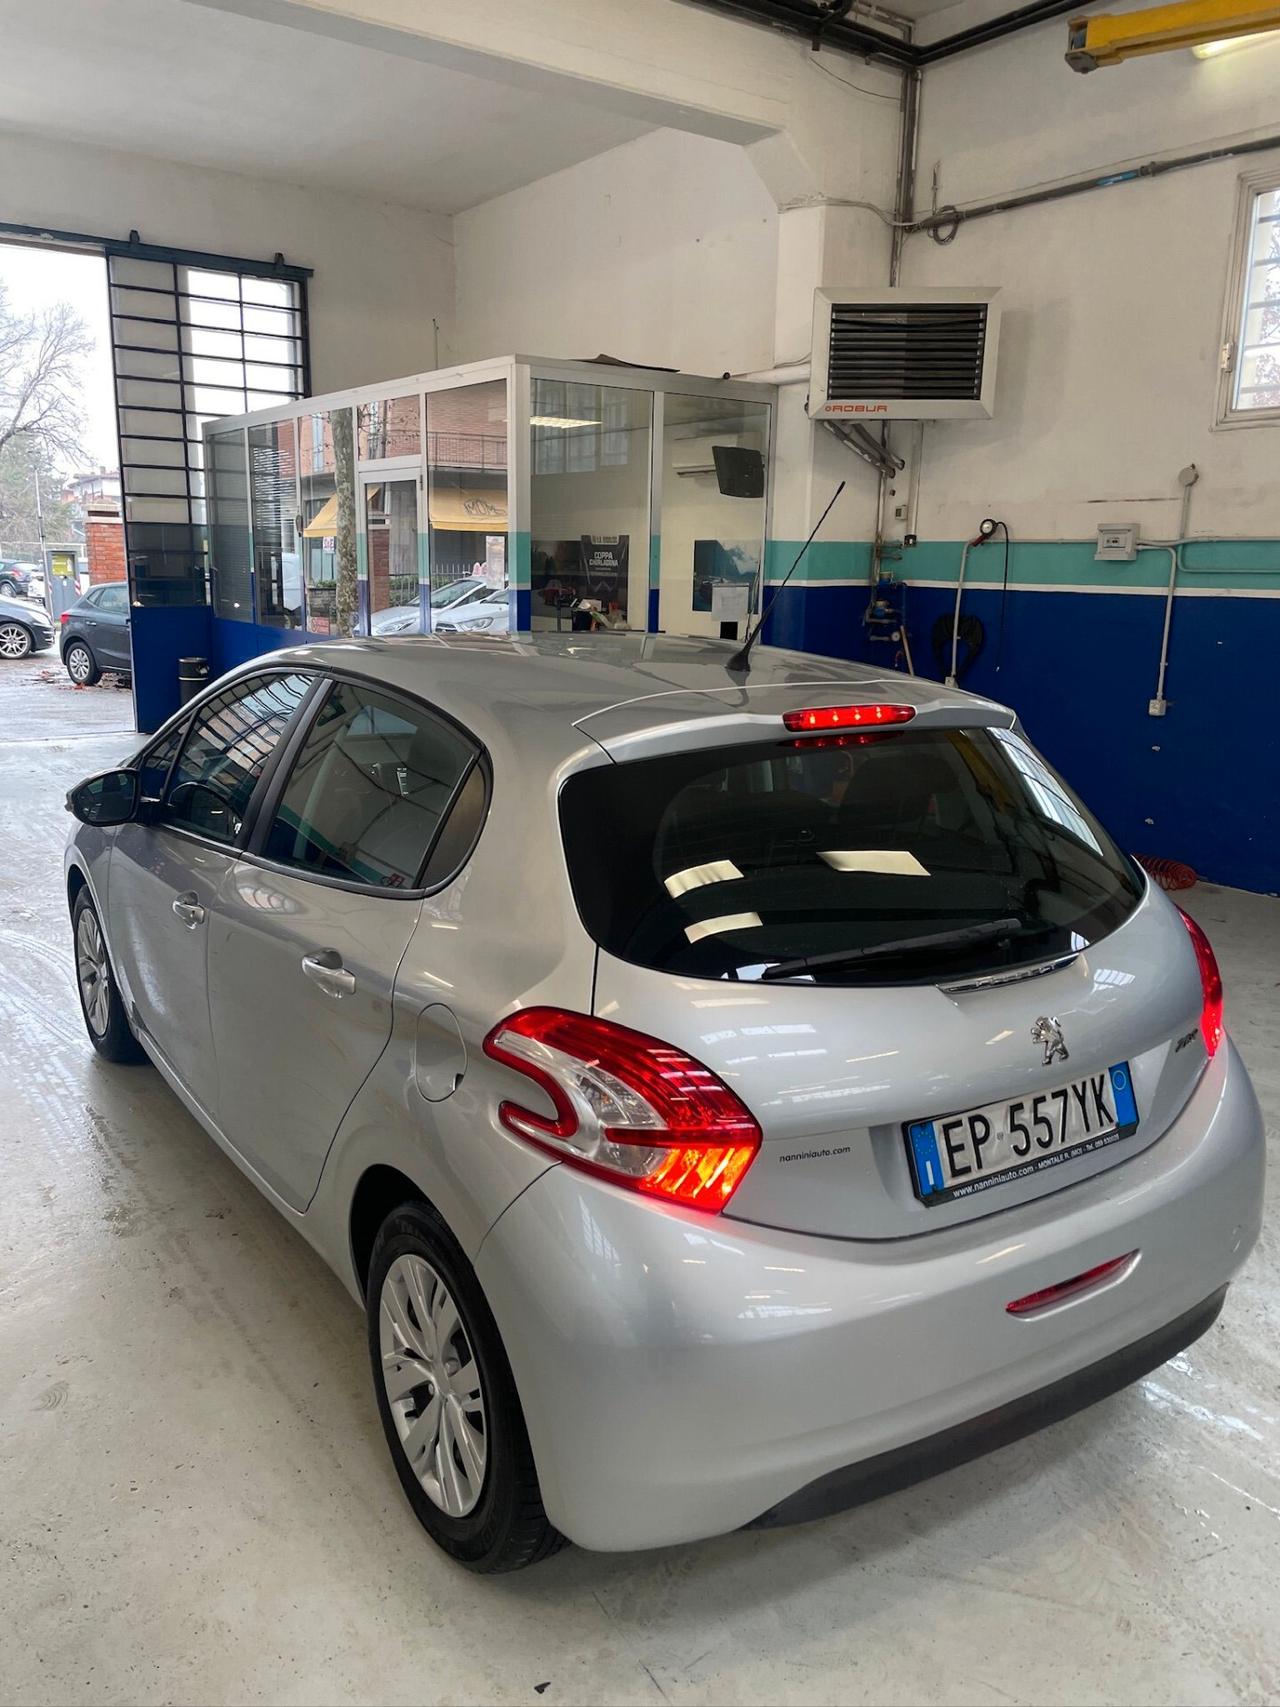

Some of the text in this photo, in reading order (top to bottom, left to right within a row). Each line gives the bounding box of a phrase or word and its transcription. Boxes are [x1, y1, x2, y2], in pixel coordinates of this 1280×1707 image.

[594, 551, 613, 560] COPPA
[942, 1074, 1114, 1178] EP 557YK
[779, 1146, 851, 1163] nanniniauto.com
[952, 1165, 1034, 1198] www.nanniniauto.com
[1038, 1155, 1064, 1169] MONTALE
